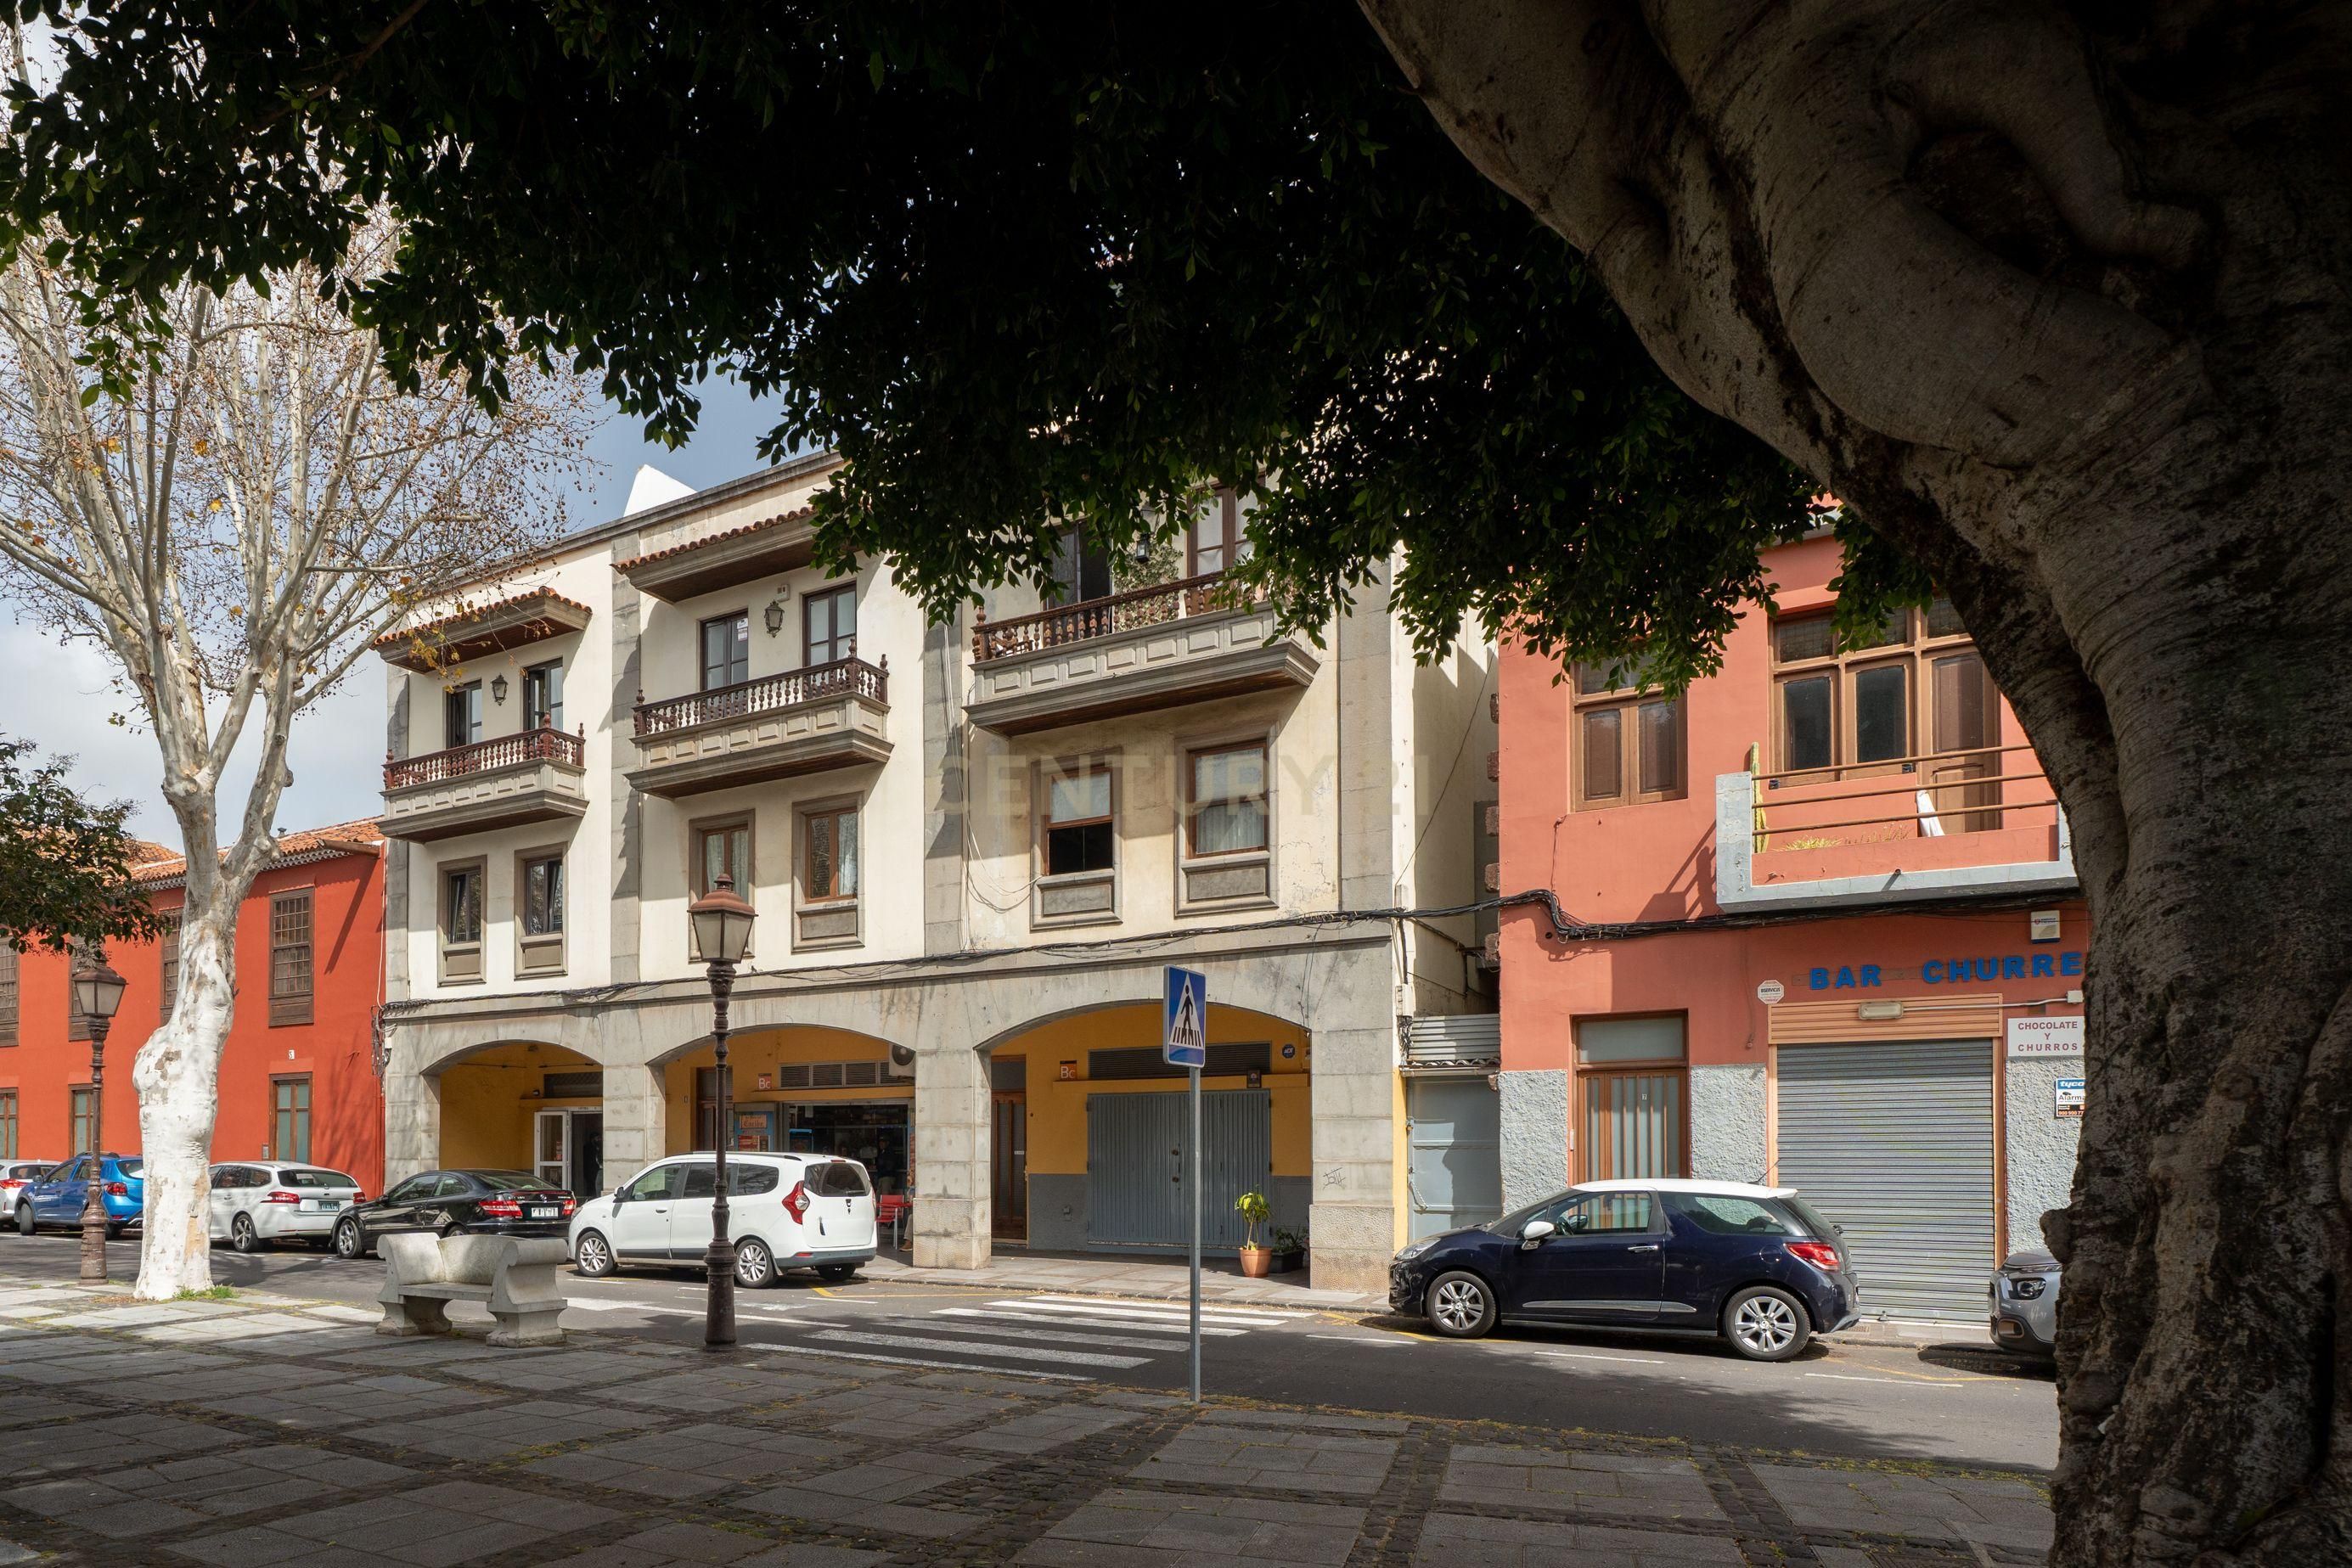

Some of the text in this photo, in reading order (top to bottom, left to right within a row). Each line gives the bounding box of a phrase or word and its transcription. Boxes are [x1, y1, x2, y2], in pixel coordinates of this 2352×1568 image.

[1810, 964, 1882, 991] BAR
[2017, 1021, 2078, 1030] CHOCOLATE
[2044, 1032, 2051, 1041] Y
[2017, 1043, 2078, 1051] CHURROS
[758, 1078, 770, 1088] Bc
